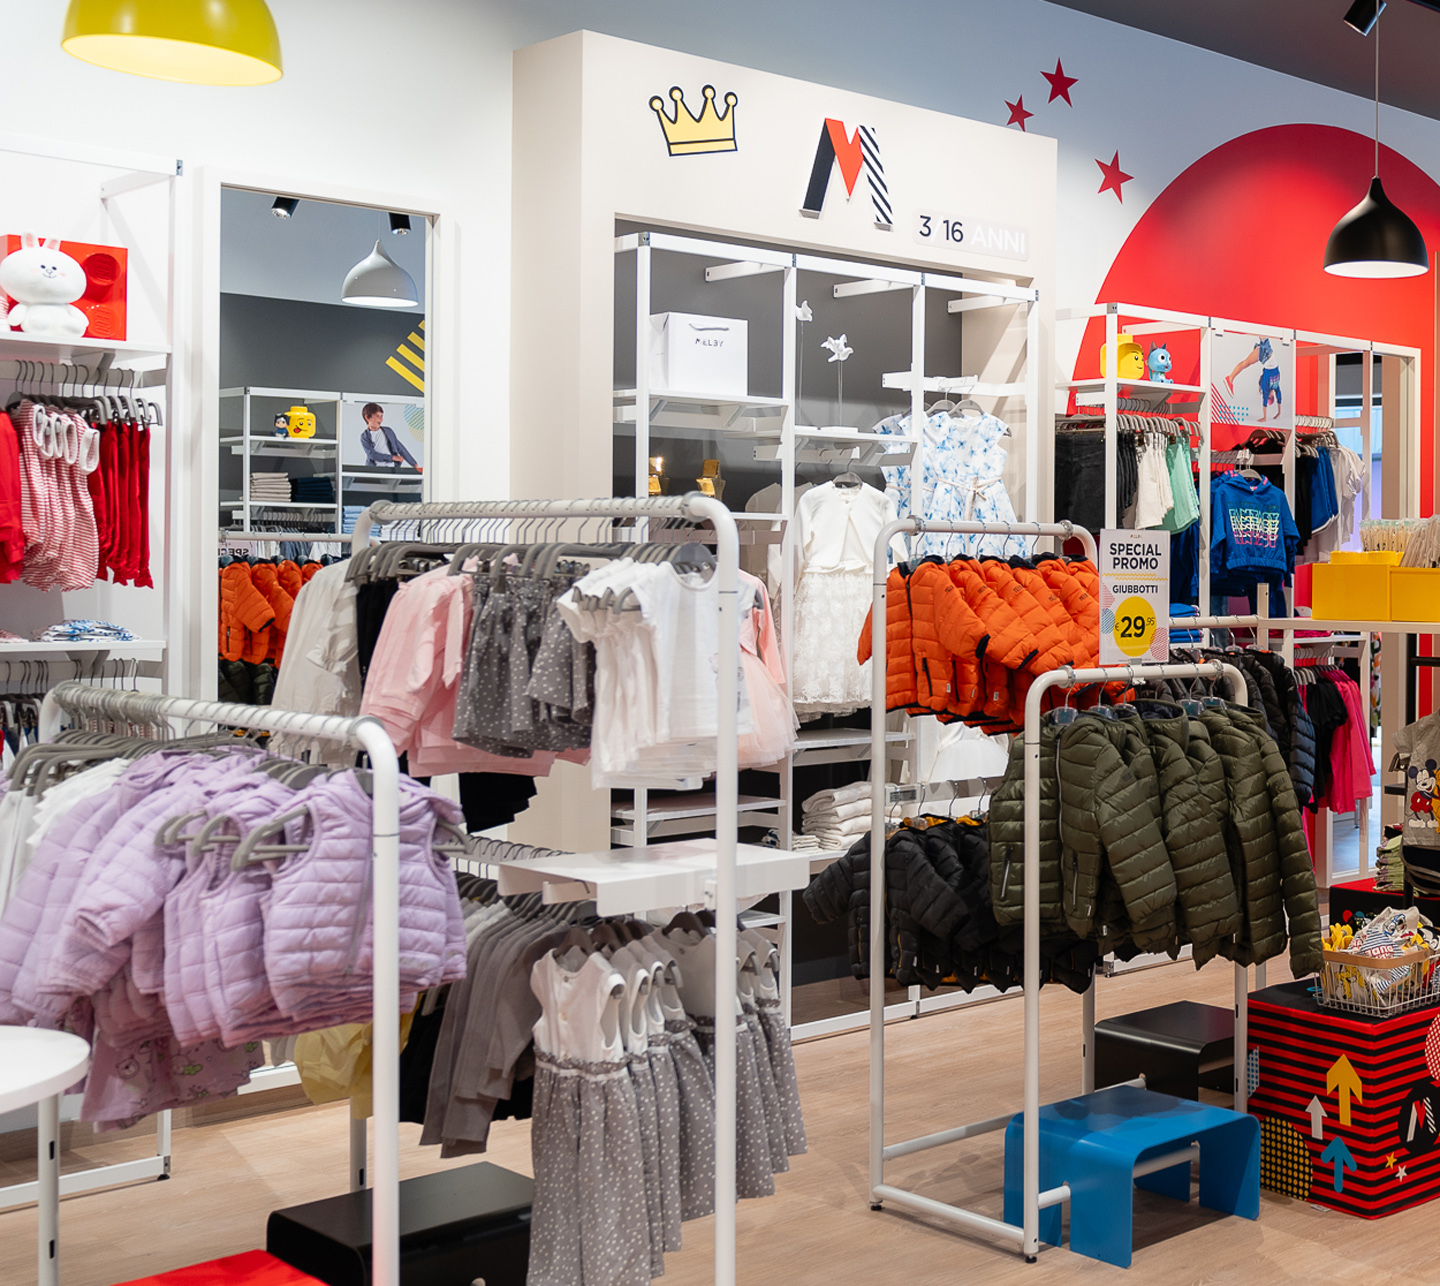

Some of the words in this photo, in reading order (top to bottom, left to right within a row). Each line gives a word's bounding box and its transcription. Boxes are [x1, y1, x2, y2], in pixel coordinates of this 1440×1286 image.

[970, 225, 1025, 254] ANNI
[1109, 543, 1162, 556] SPECIAL
[1112, 558, 1159, 570] PROMO
[1112, 585, 1158, 594] GIUBBOTTI
